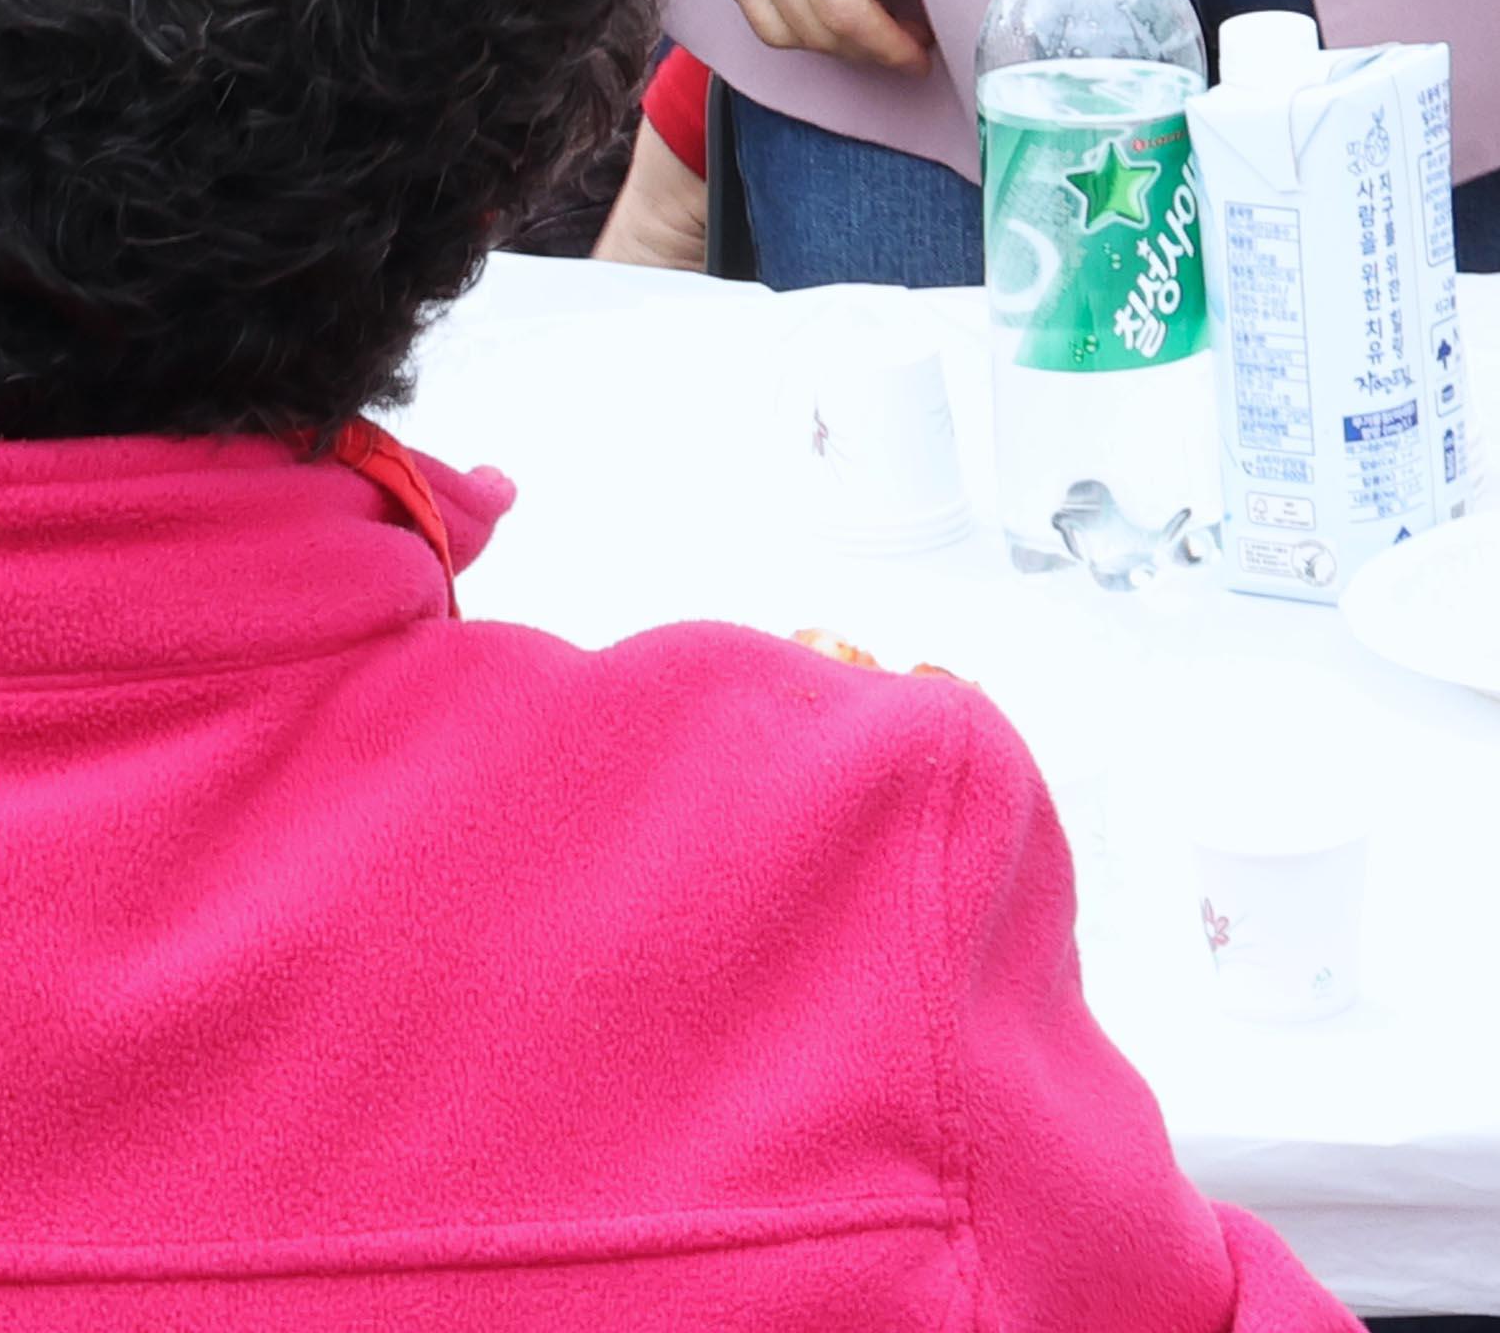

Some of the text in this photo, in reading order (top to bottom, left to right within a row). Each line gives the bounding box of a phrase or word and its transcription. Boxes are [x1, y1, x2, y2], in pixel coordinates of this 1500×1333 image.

[1112, 152, 1198, 360] 칠성사이
[1356, 178, 1384, 365] 사람을 위한 치유
[1379, 169, 1395, 247] 지구를
[1387, 252, 1401, 304] 위한
